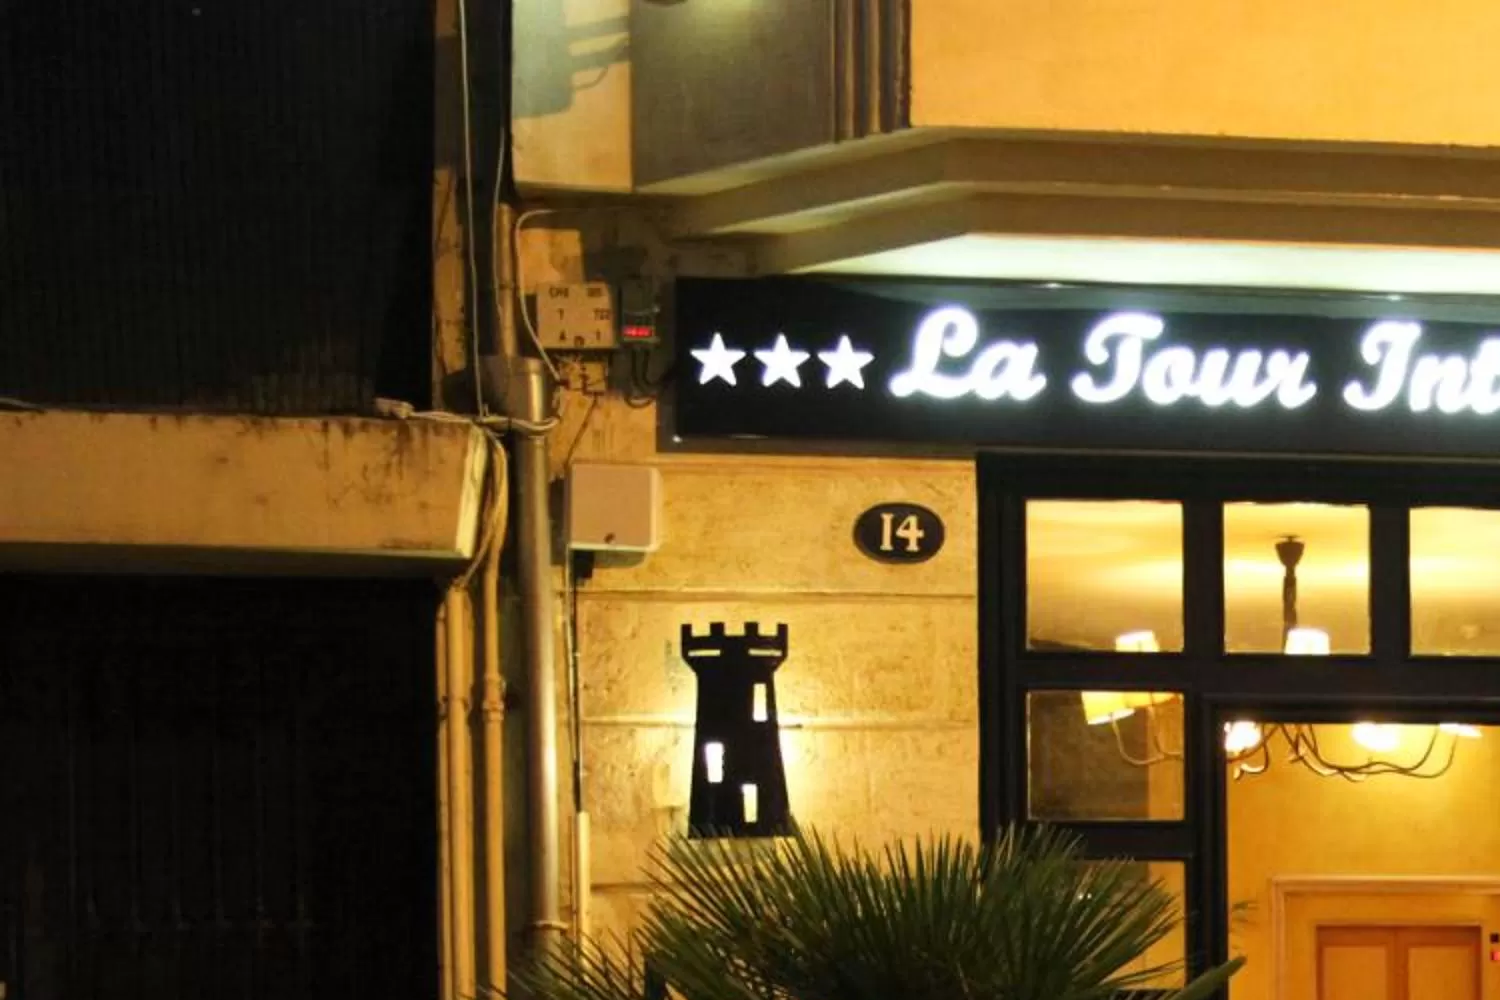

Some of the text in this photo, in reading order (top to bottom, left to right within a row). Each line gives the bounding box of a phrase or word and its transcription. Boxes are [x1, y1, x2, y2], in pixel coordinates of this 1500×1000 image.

[887, 304, 1048, 402] La
[1070, 311, 1319, 409] Tour
[879, 512, 925, 552] 14
